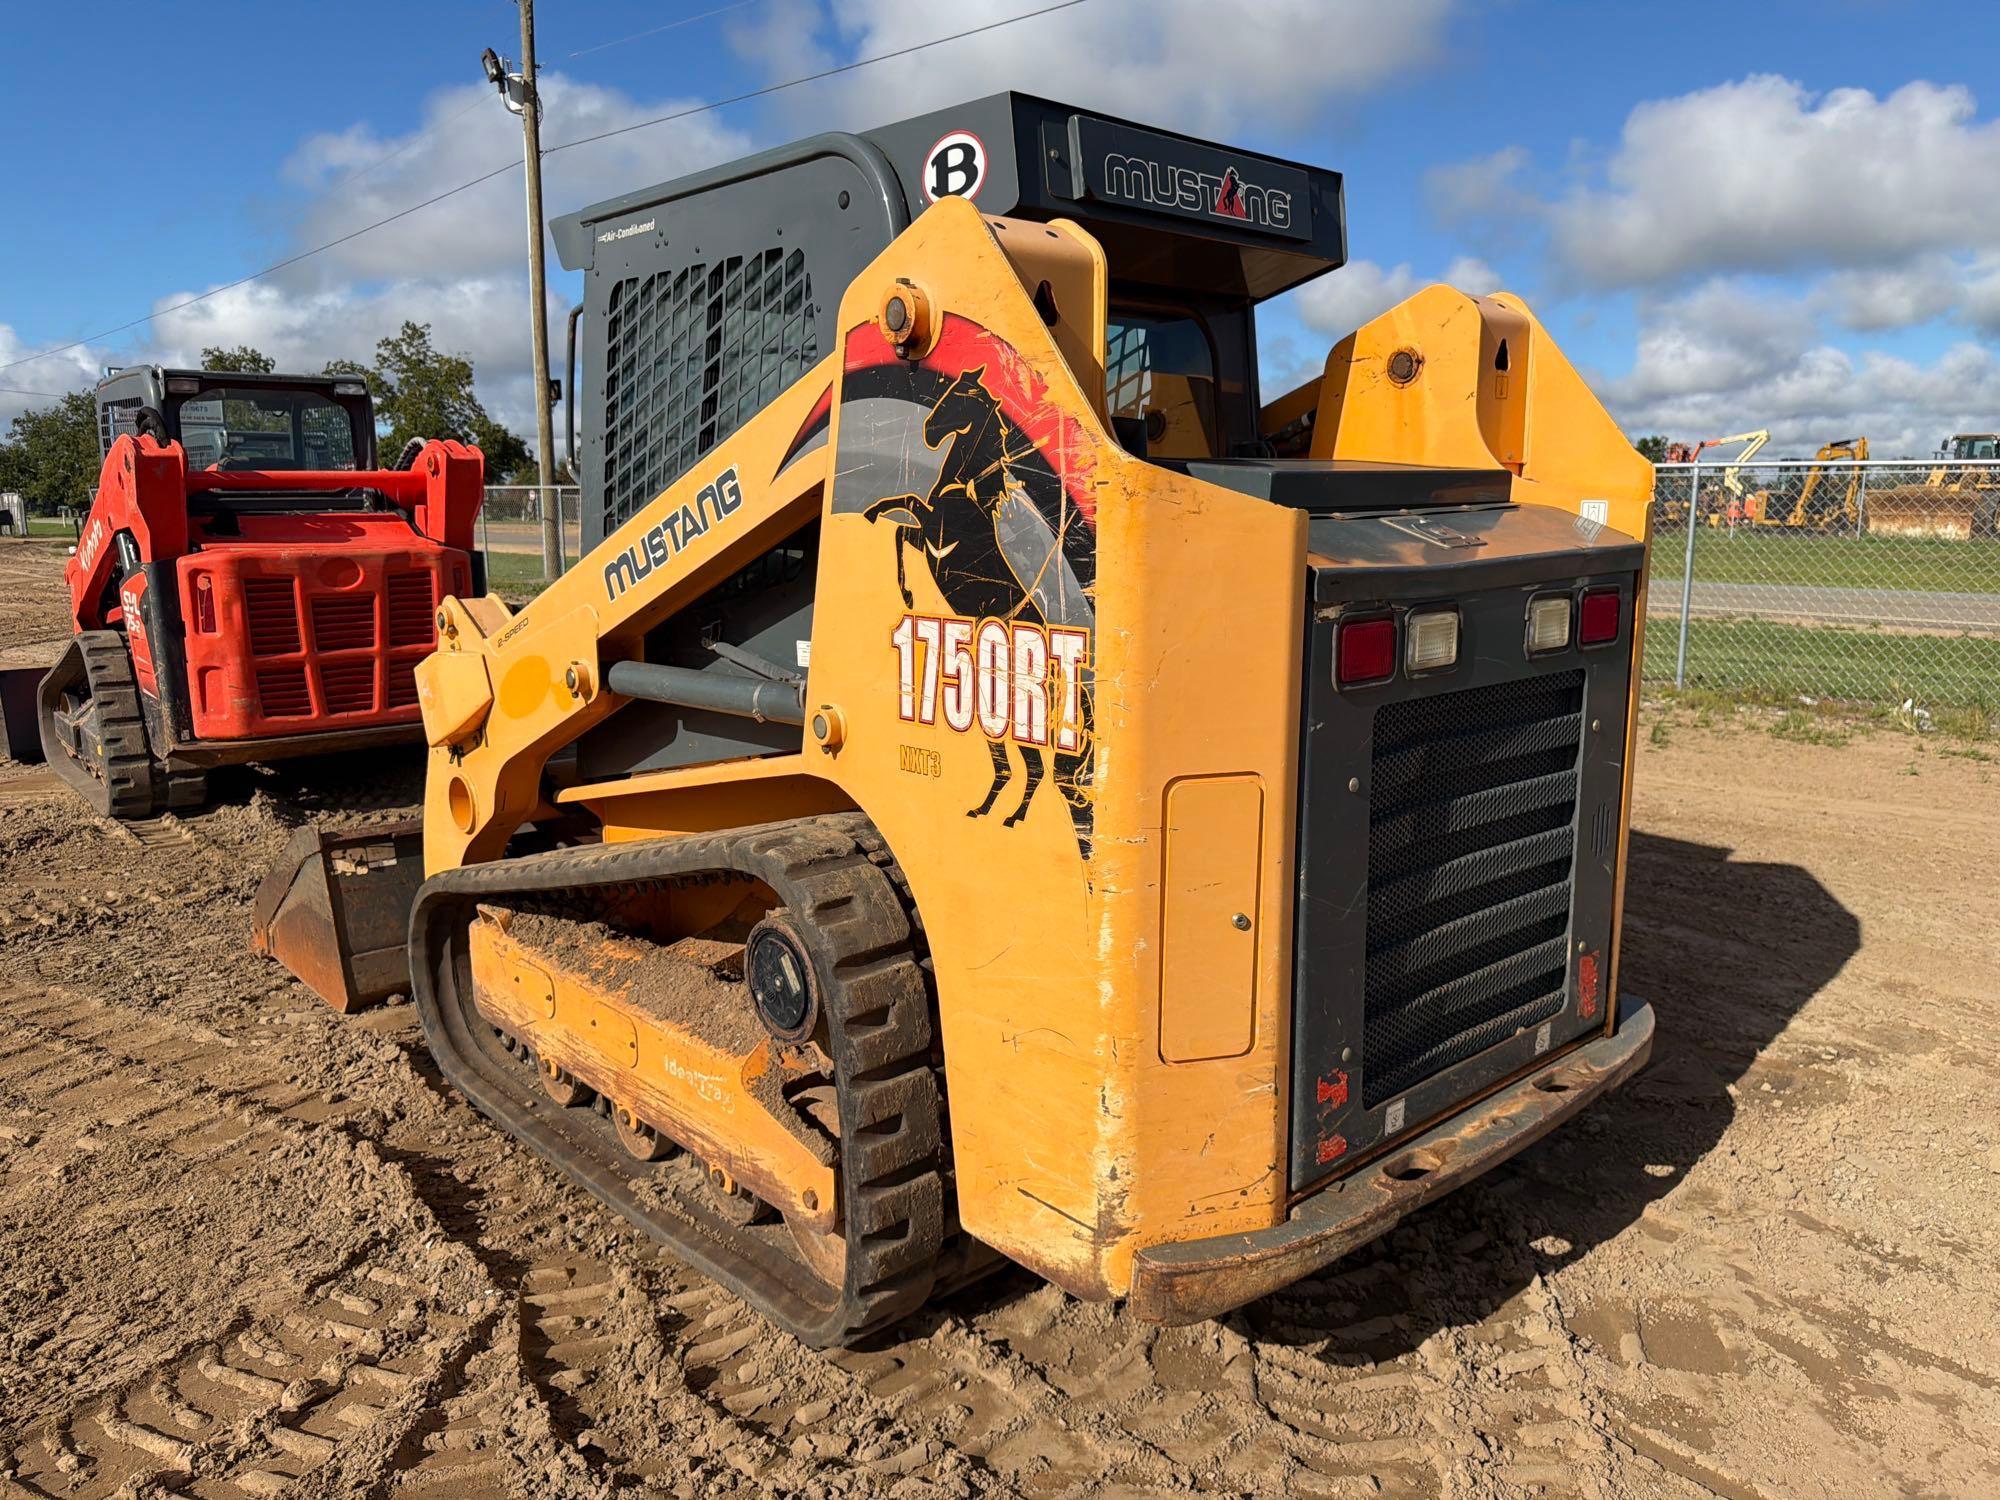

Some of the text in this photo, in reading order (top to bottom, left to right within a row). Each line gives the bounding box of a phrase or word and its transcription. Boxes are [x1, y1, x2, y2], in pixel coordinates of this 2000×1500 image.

[1105, 152, 1291, 229] MUSTANG
[605, 217, 655, 242] Air-Conditioned
[80, 518, 103, 573] Kubota
[603, 466, 743, 603] MUSTANG
[497, 617, 529, 648] 2-SPEED
[891, 614, 1087, 752] 1750RT
[900, 744, 942, 778] NXT3
